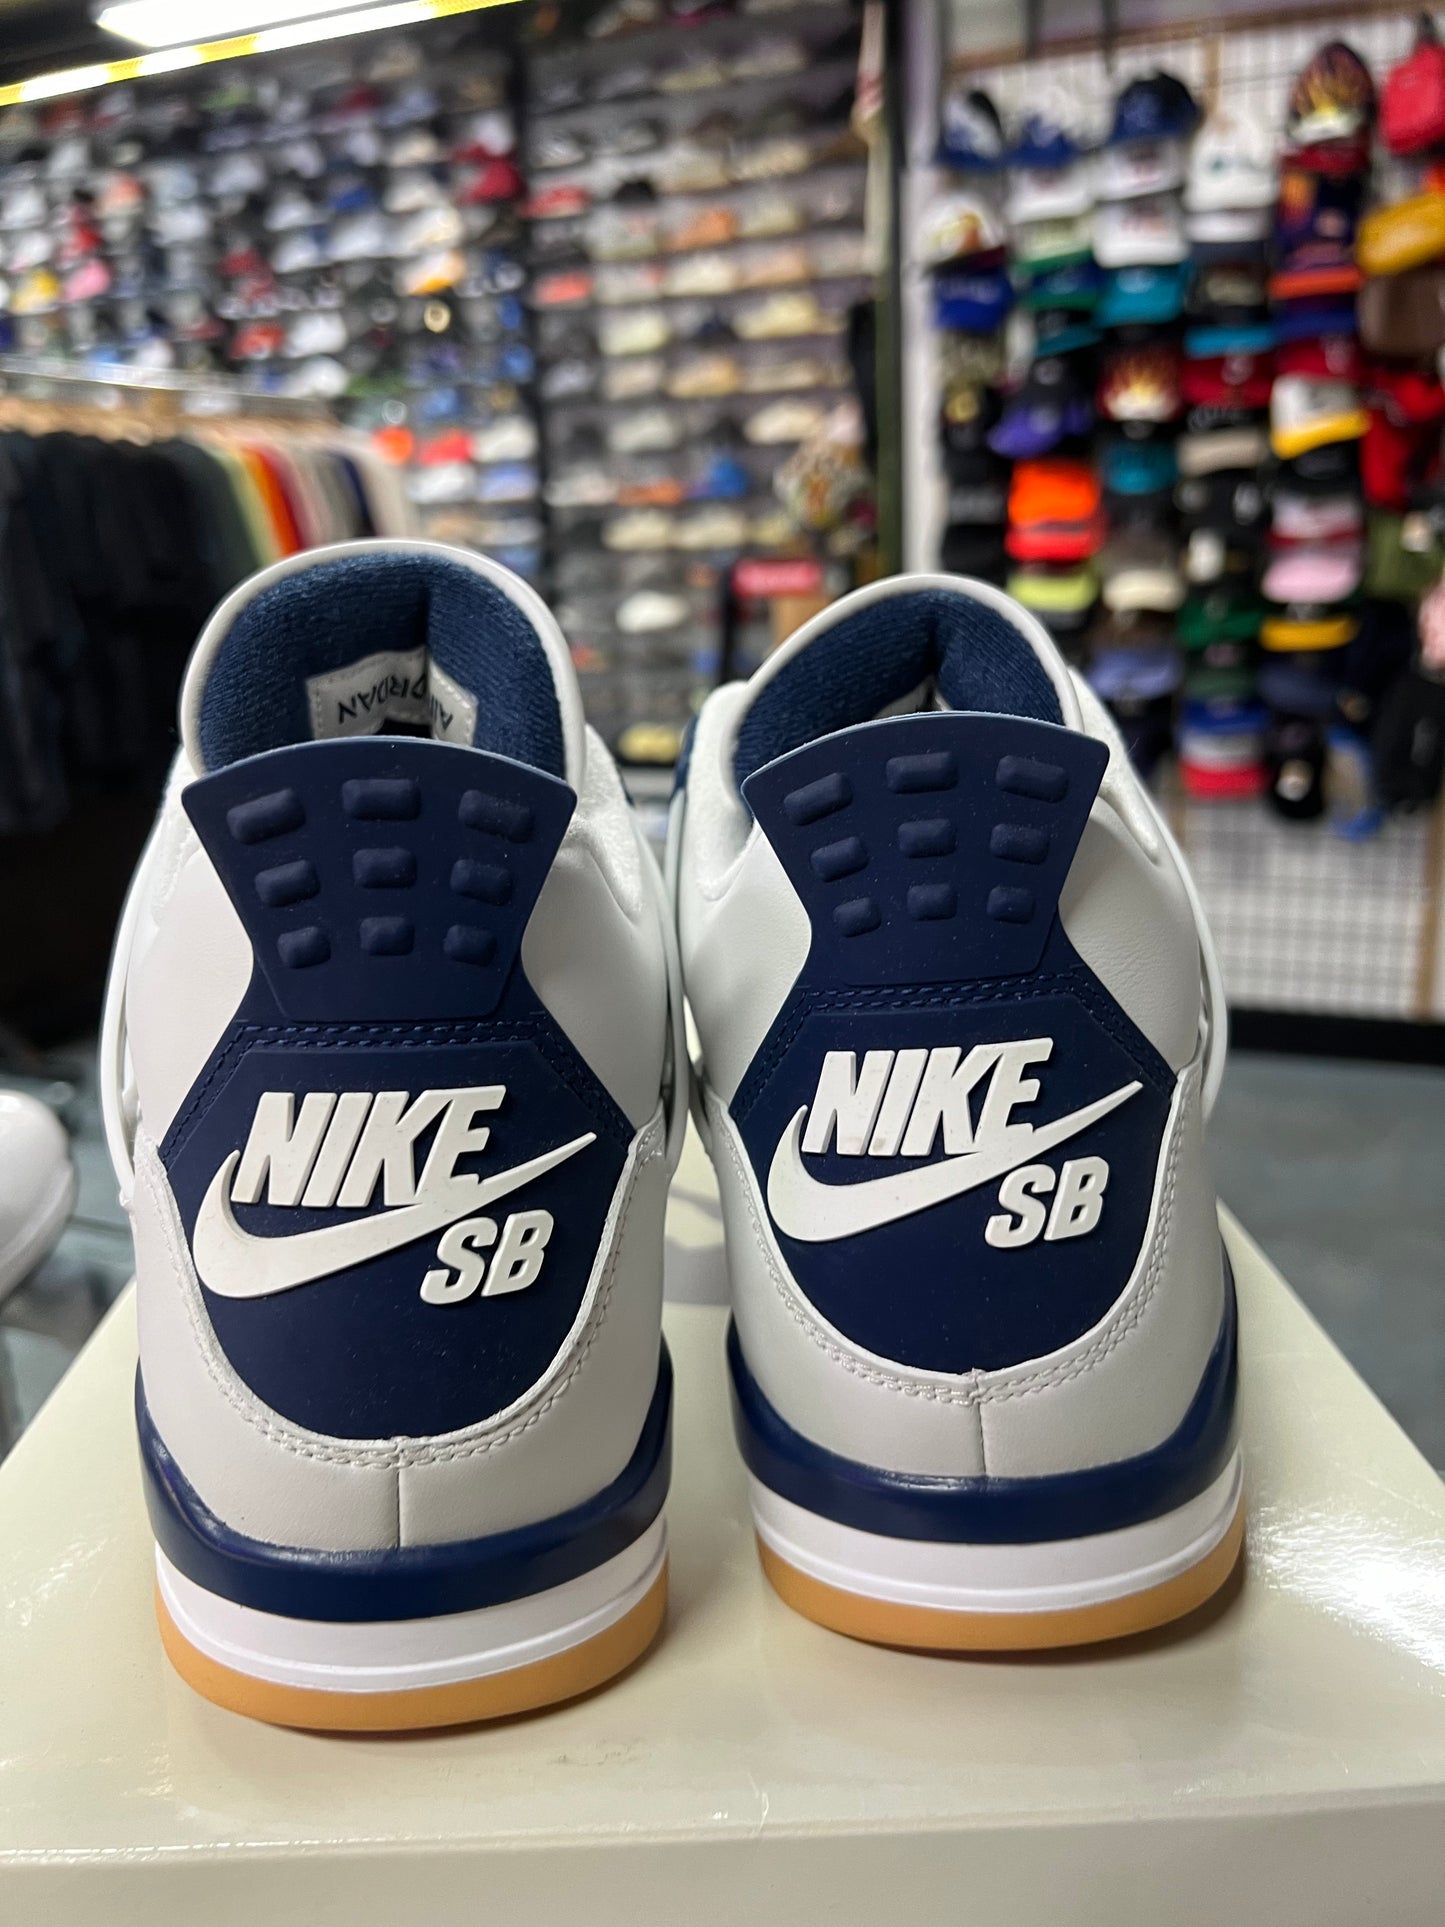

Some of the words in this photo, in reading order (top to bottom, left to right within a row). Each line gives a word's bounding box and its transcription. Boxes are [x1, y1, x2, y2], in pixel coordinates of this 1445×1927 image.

[338, 673, 428, 725] ORDAN
[801, 1037, 1053, 1156] NIKE
[230, 1085, 506, 1208] NIKE
[985, 1156, 1109, 1249] SB
[420, 1209, 554, 1305] SB
